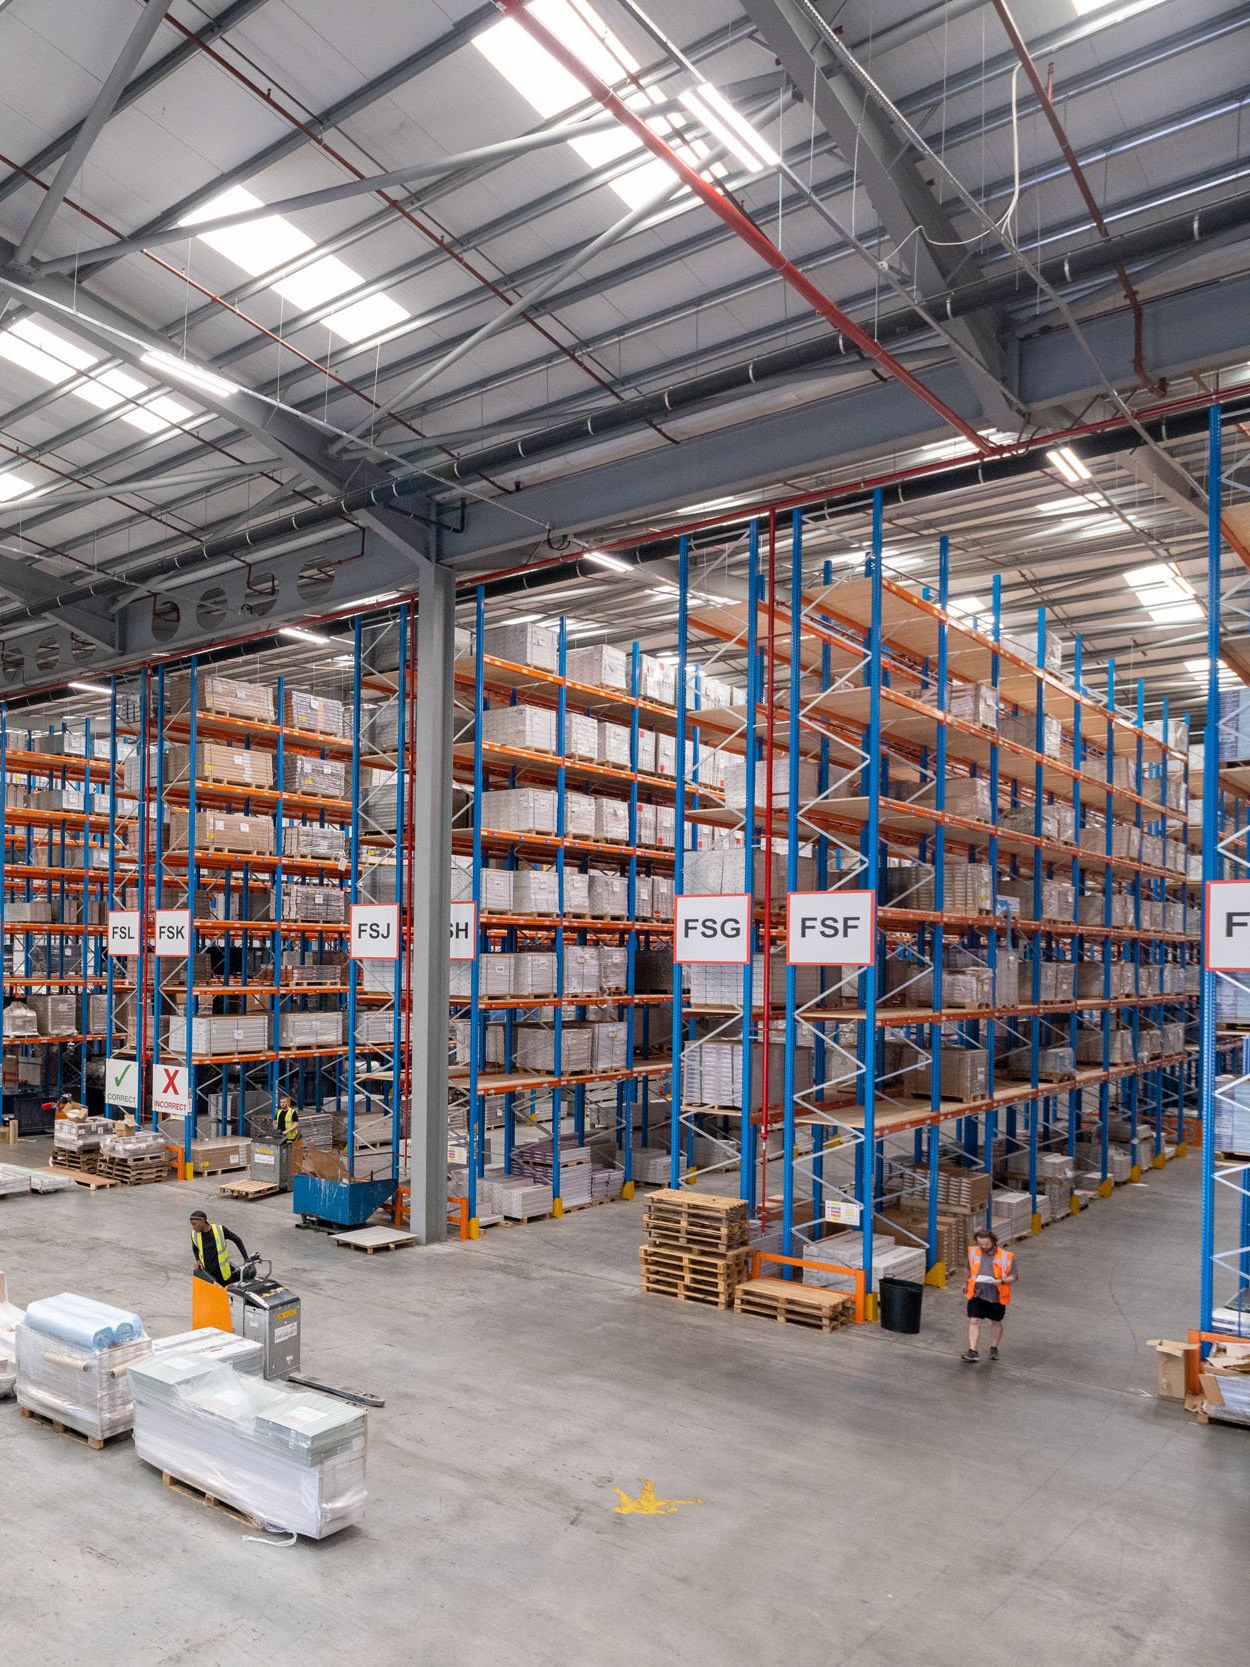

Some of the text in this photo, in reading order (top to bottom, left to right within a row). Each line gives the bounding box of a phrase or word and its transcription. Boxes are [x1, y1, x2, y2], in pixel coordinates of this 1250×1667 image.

[111, 925, 135, 940] FSL
[158, 925, 186, 940] FSK
[357, 922, 391, 939] FSJ
[683, 917, 742, 939] FSG
[800, 916, 861, 938] FSF
[107, 1092, 136, 1103] CORRECT
[154, 1100, 187, 1111] INCORRECT
